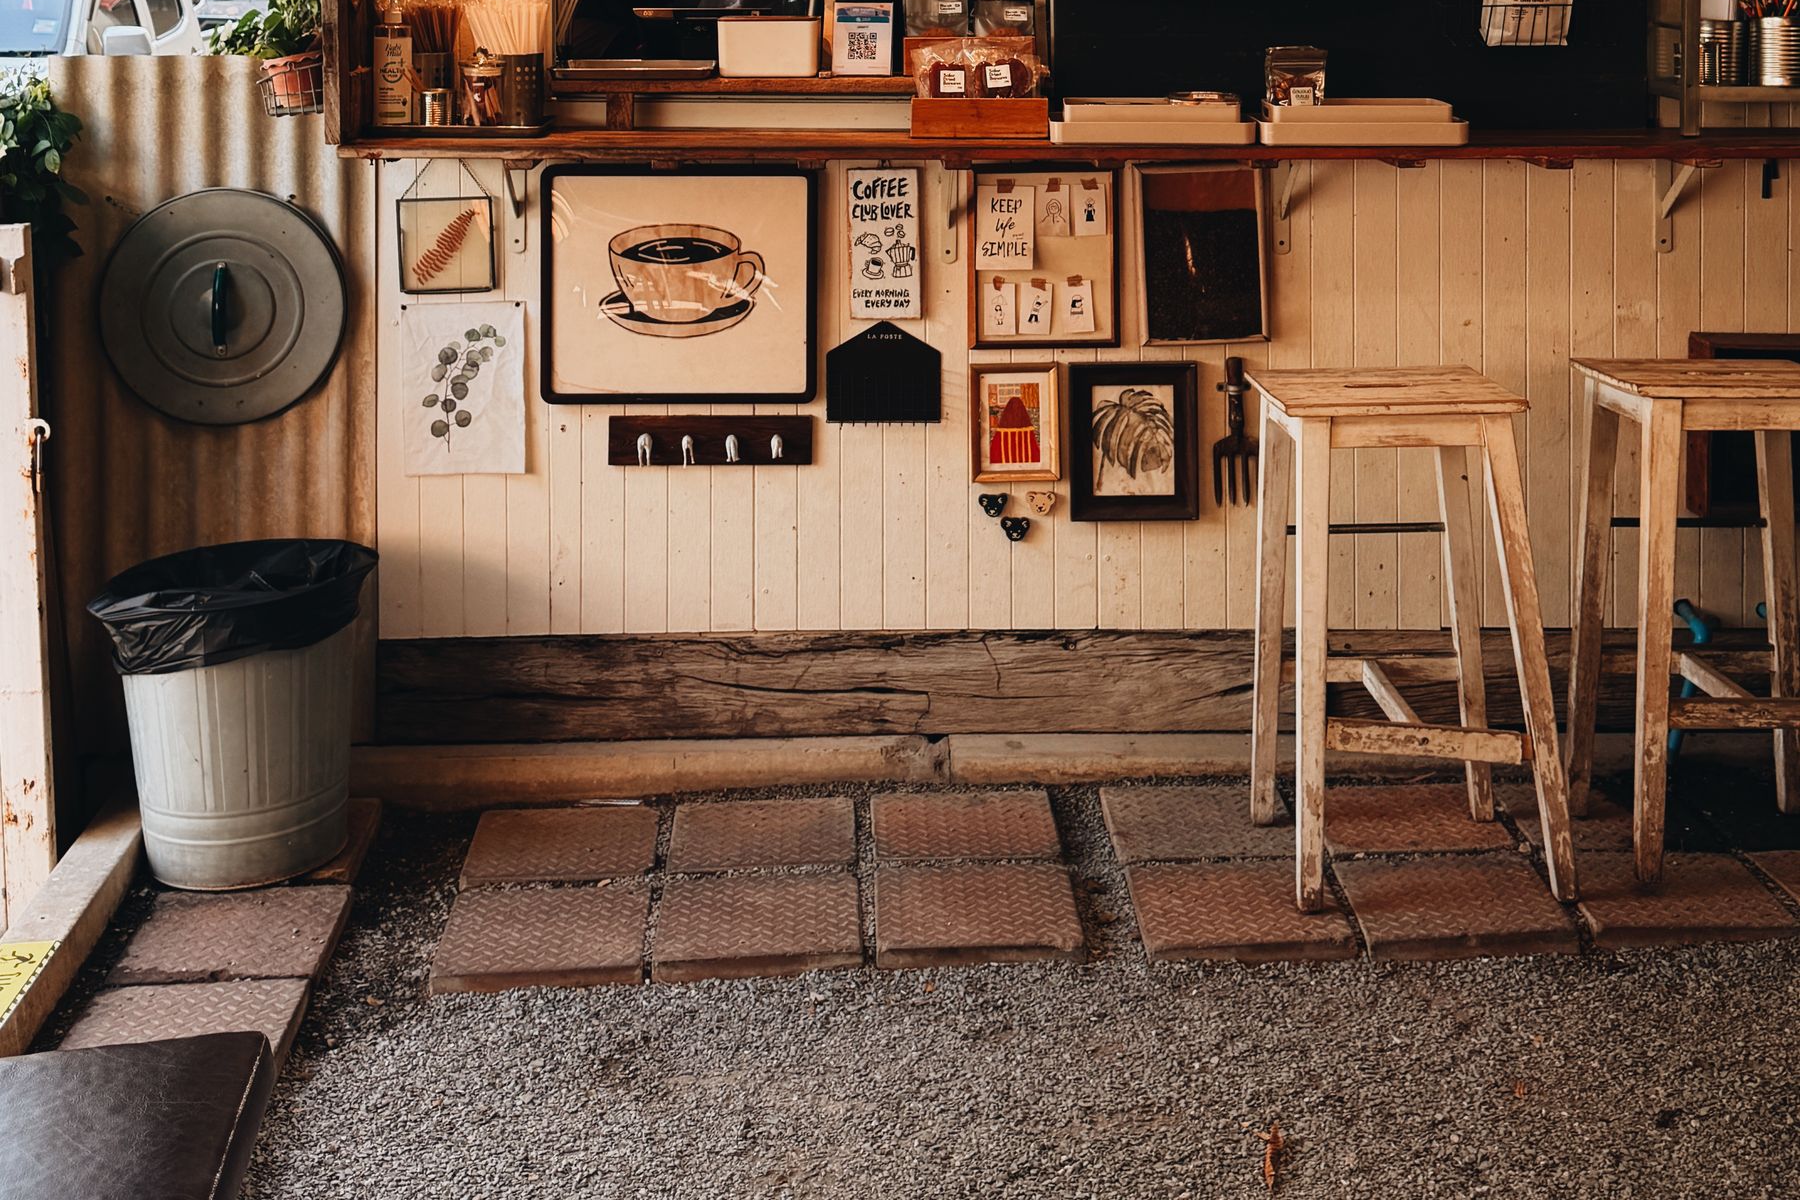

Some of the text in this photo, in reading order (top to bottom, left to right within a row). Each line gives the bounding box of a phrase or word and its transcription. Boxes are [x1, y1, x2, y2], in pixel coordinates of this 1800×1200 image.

[852, 176, 909, 200] COFFEE
[851, 202, 915, 220] CLUB LOVER
[990, 197, 1022, 214] KEEP
[995, 216, 1016, 238] life
[981, 240, 1029, 258] SIMPLE
[852, 288, 910, 299] EVERY MORNING
[864, 299, 911, 308] EVERY DAY
